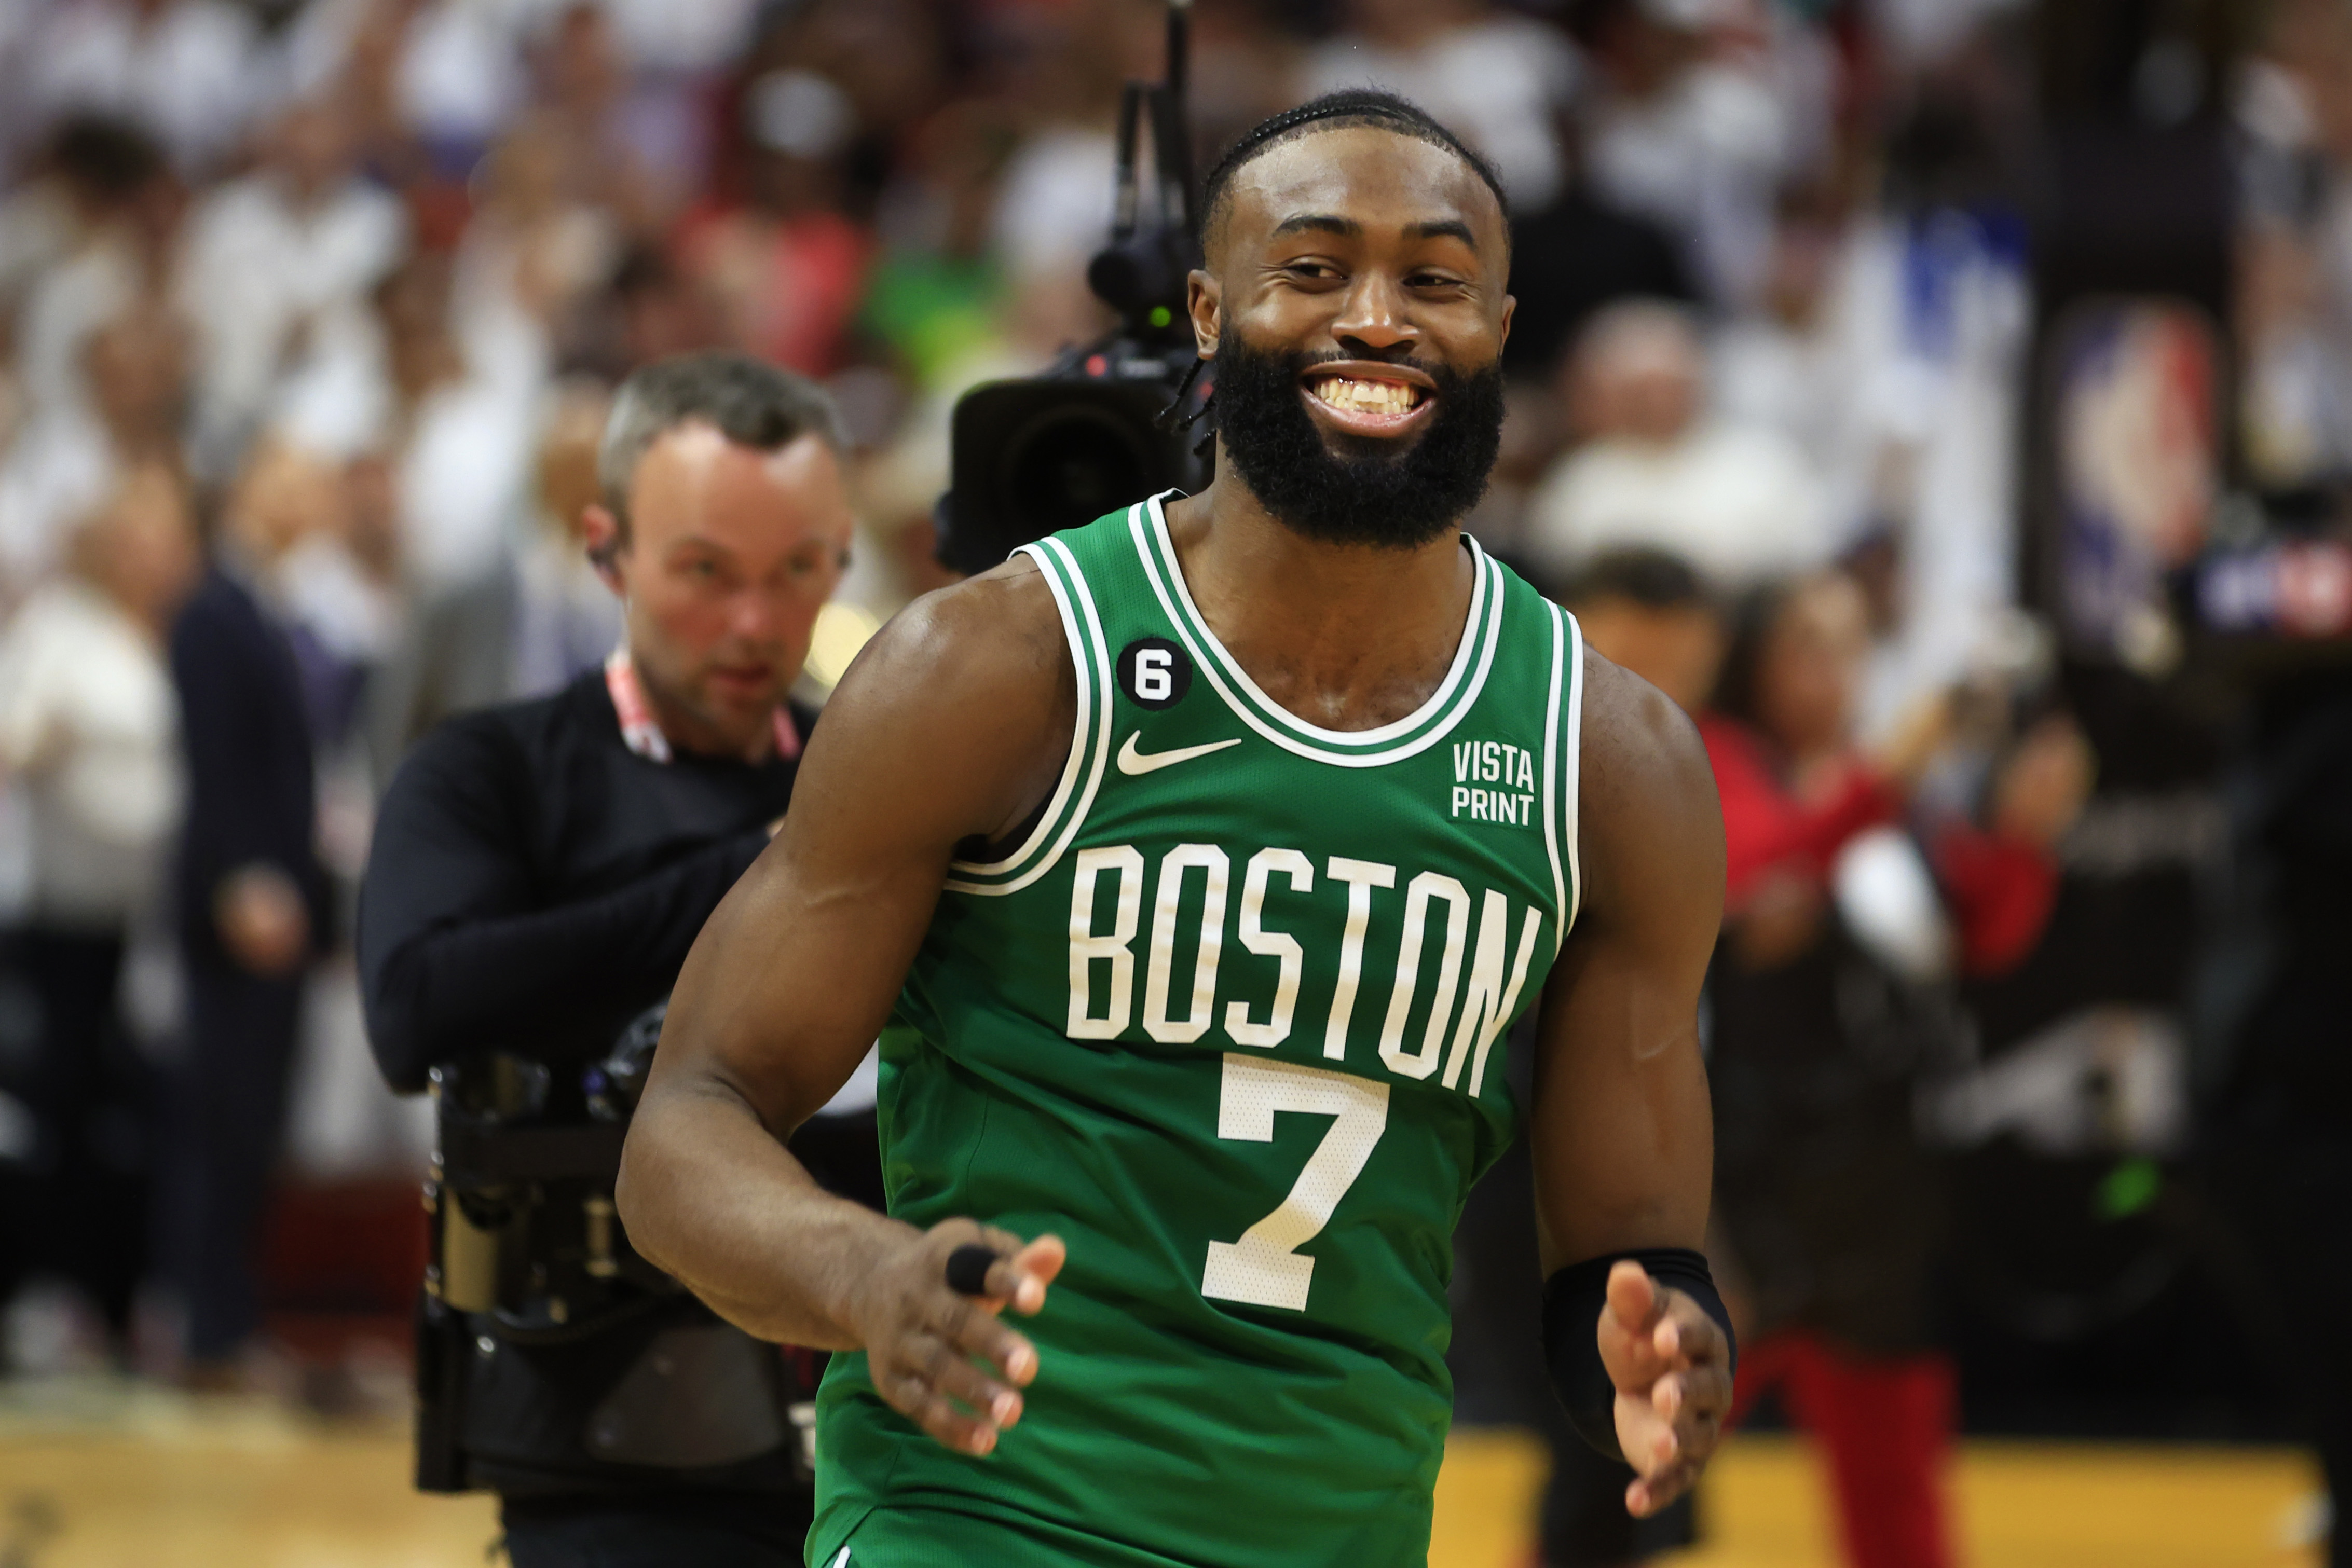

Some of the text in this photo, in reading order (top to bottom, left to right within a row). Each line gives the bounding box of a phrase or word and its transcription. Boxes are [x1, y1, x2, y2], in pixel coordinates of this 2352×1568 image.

[1134, 648, 1172, 701] 6
[1453, 740, 1535, 794] VISTA
[1452, 786, 1535, 827] PRINT
[1065, 843, 1543, 1099] BOSTON
[1200, 1050, 1390, 1313] 7
